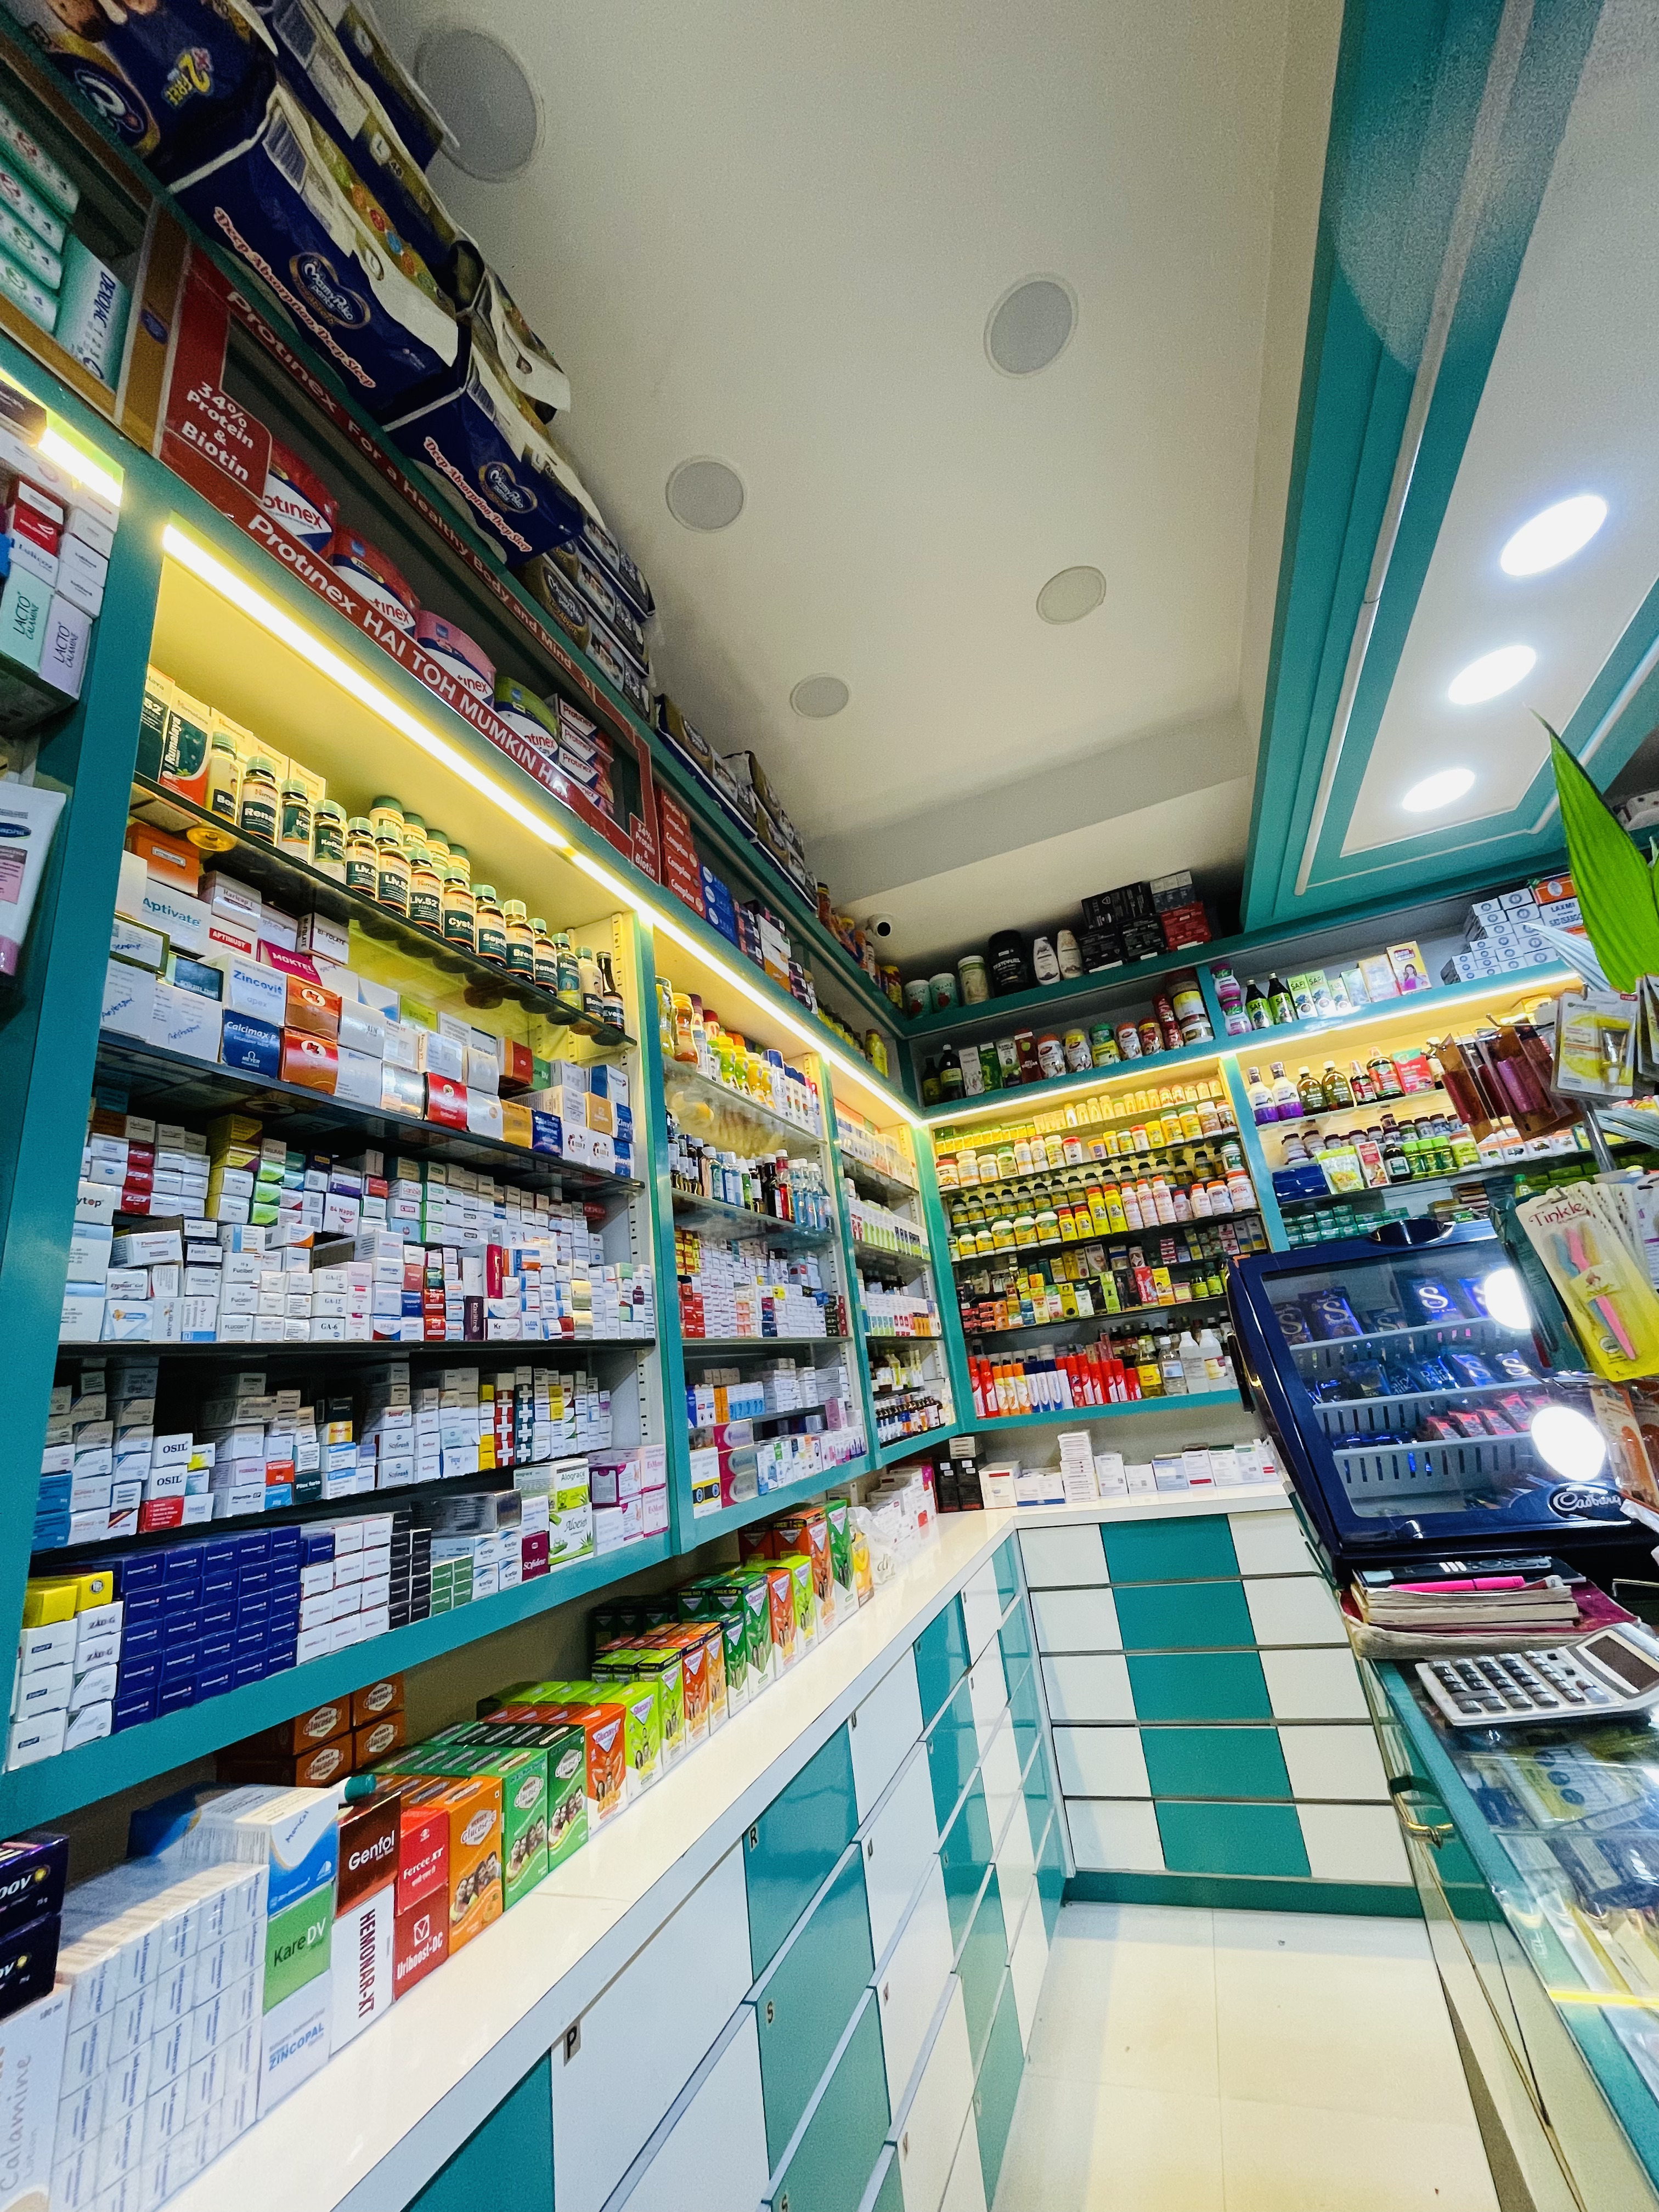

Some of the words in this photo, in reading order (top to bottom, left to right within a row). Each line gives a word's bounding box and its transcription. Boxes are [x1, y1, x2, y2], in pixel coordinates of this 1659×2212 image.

[94, 270, 116, 329] DEXOLAC
[198, 381, 248, 428] 34%
[187, 390, 255, 449] Protein
[213, 430, 227, 446] &
[181, 421, 250, 482] Biotin
[227, 291, 337, 413] Protinex
[347, 419, 382, 460] For
[403, 480, 469, 556] Healthy
[473, 555, 510, 603] Body
[514, 604, 538, 633] and
[540, 630, 573, 670] Mind
[13, 595, 31, 635] LACTO
[25, 603, 40, 640] CALAMINE
[53, 625, 70, 664] LACTO
[66, 633, 78, 669] CALAMINE
[248, 514, 360, 616] Protinex
[363, 610, 407, 659] HAI
[412, 654, 456, 701] TOH
[459, 695, 537, 772] MUMKIN
[563, 704, 594, 729] Protinex
[165, 715, 181, 765] Rumalaya
[564, 729, 592, 753] Protinex
[562, 752, 592, 775] Protinex
[635, 832, 656, 856] Protein
[637, 823, 652, 843] 34%
[665, 832, 689, 859] Complan
[635, 855, 656, 878] Biotin
[667, 856, 691, 882] Complan
[670, 878, 695, 904] Complan
[142, 898, 201, 928] Aptivate
[1550, 902, 1576, 913] LAXMI
[233, 969, 283, 996] Zincovit
[1291, 981, 1306, 991] SAFI
[225, 1020, 269, 1040] Calcimax
[1529, 1202, 1584, 1227] Tinkle
[162, 1443, 188, 1454] OSIL
[156, 1476, 182, 1486] OSIL
[561, 1471, 585, 1482] Alograce
[1553, 1491, 1622, 1512] Cadbury
[348, 1830, 395, 1871] Genfol
[750, 1826, 758, 1849] R
[397, 1932, 444, 1980] Uriboost-DC
[766, 2001, 774, 2024] S
[566, 2025, 578, 2059] P
